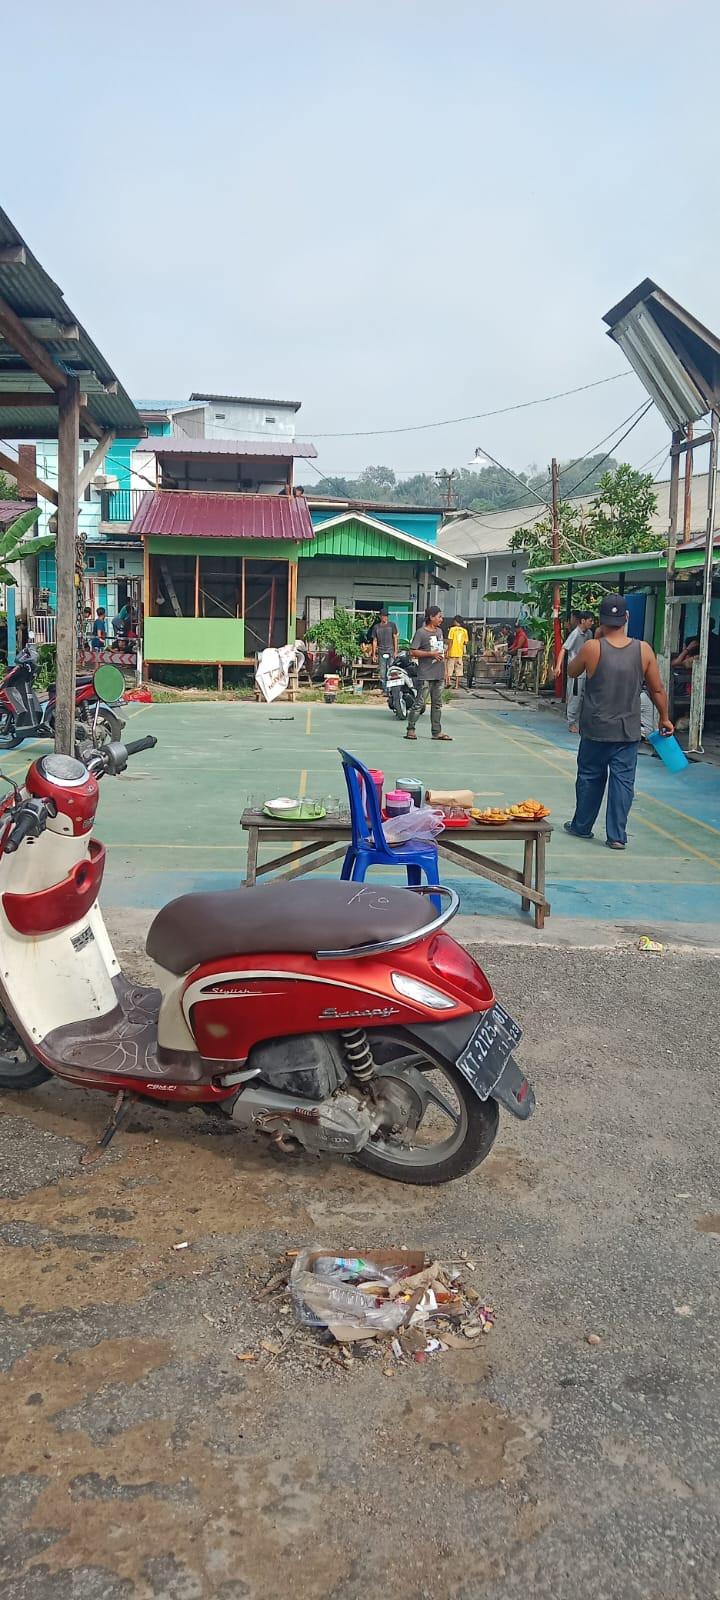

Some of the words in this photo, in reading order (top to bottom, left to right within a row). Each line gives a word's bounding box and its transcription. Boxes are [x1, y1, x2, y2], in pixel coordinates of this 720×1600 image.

[318, 1007, 400, 1019] Scoopy
[460, 1051, 480, 1079] KT
[474, 1020, 498, 1058] 2125
